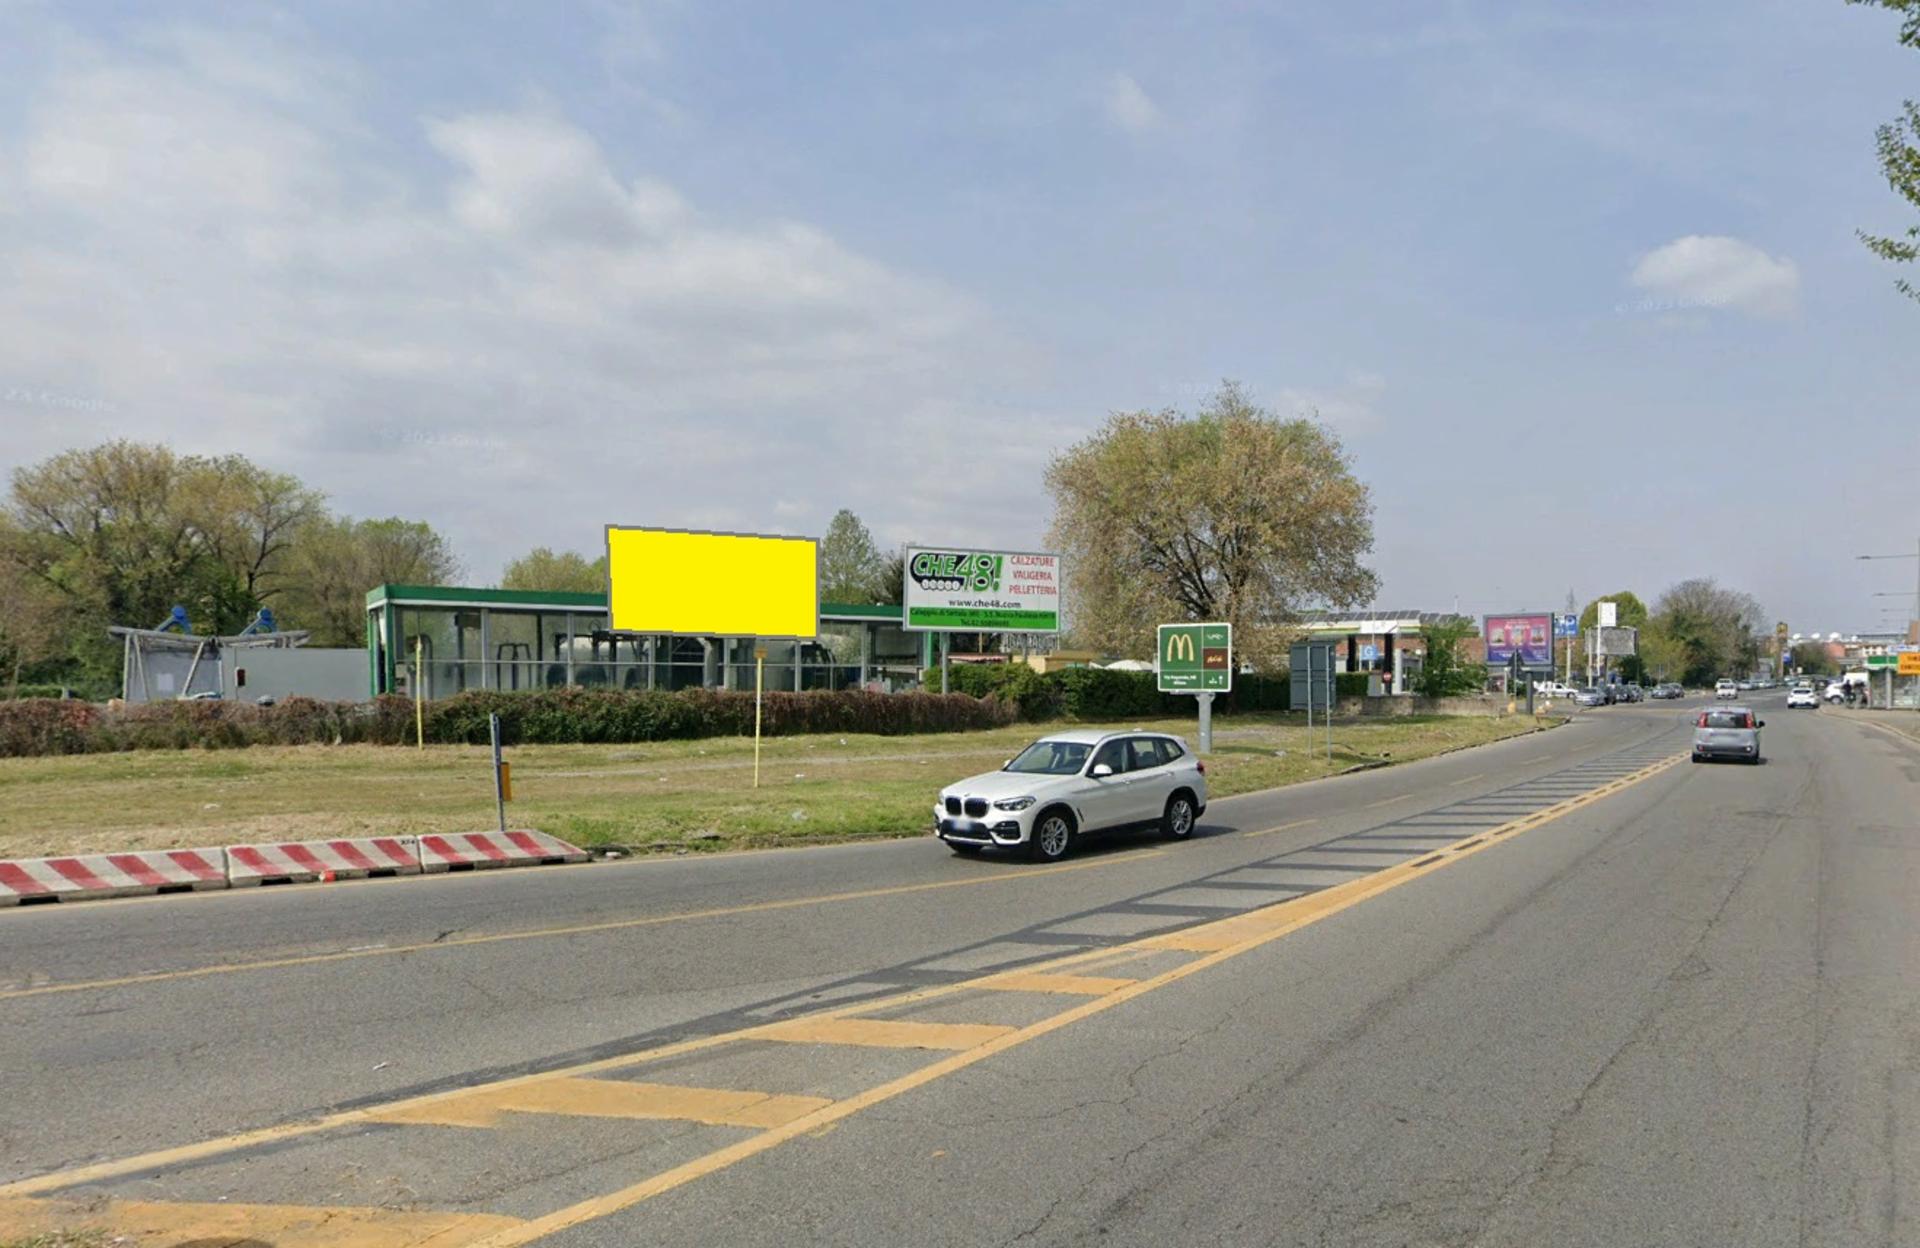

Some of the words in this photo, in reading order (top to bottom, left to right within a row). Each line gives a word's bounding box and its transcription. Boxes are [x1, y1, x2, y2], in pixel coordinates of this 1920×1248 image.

[1010, 555, 1055, 567] CALZATURE
[1012, 570, 1053, 581] VALIGERIA
[1008, 584, 1057, 595] PELLETTERIA
[948, 598, 1022, 609] www.che48.com
